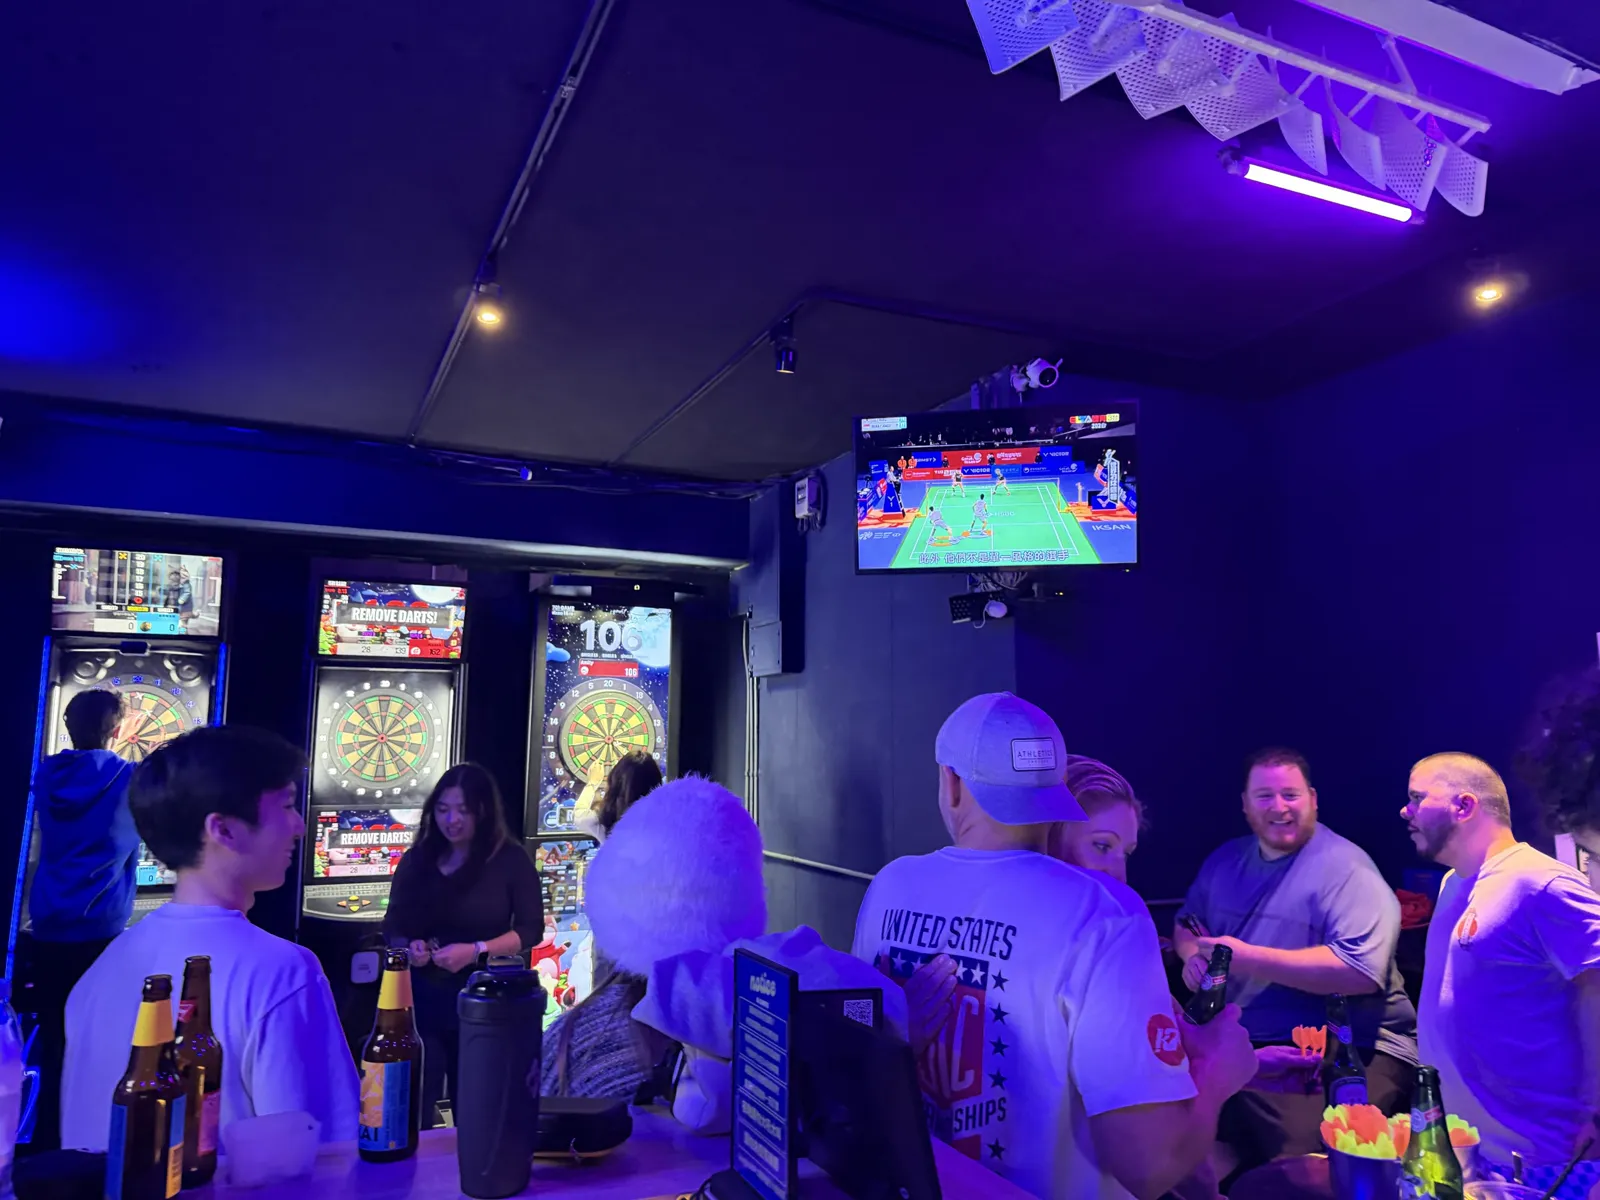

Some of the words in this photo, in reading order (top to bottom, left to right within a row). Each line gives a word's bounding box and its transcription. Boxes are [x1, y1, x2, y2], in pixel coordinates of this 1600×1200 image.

[352, 607, 397, 622] REMOVE
[398, 609, 438, 624] DARTS!
[580, 619, 642, 652] 106
[624, 668, 638, 676] 106
[340, 832, 379, 845] REMOVE
[380, 831, 413, 844] DARTS!
[881, 908, 947, 949] UNITED
[947, 915, 1017, 961] STATES
[749, 972, 777, 998] notice
